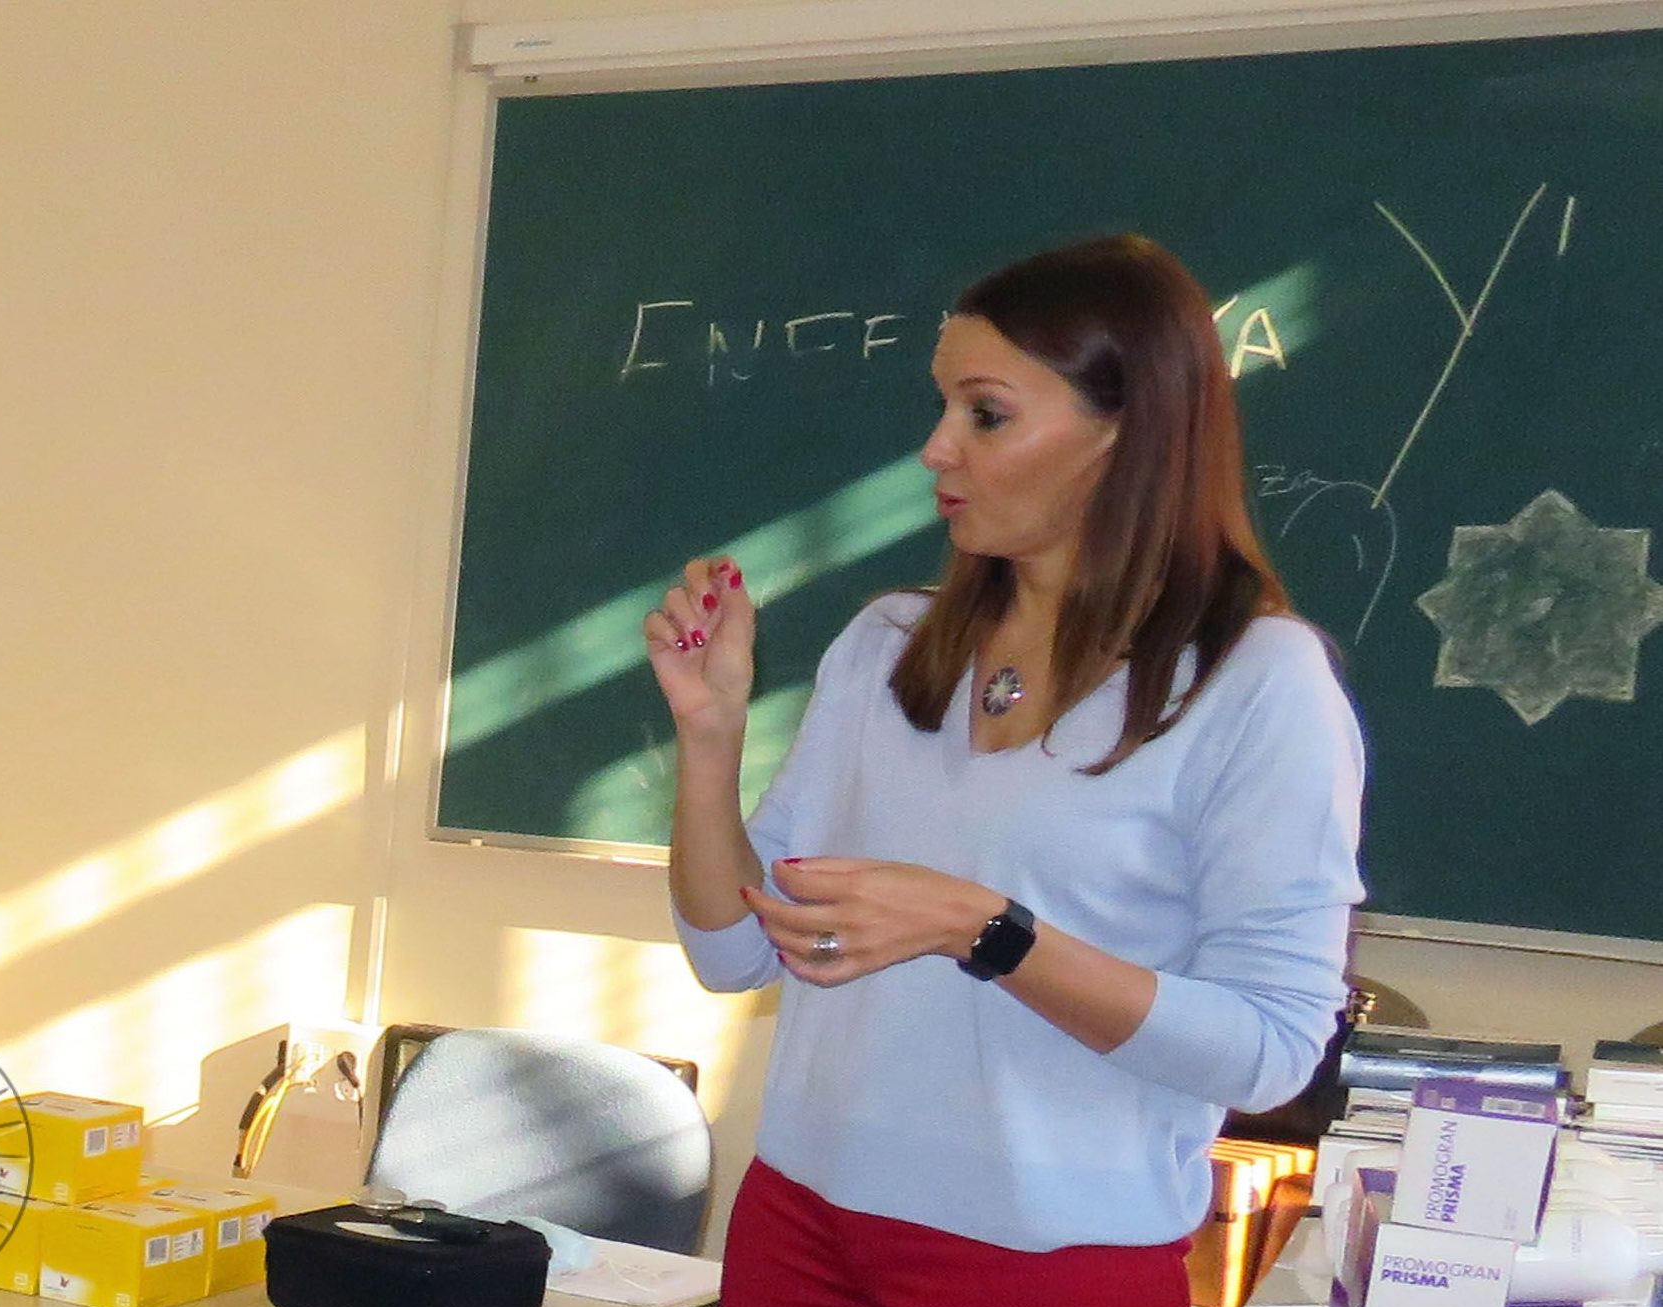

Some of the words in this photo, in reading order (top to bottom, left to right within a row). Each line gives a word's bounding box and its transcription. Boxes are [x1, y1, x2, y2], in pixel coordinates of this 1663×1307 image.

[1425, 1120, 1459, 1220] PROMOGRAN
[1441, 1163, 1468, 1223] PRISMA
[1380, 1269, 1450, 1289] PRISMA
[1383, 1254, 1501, 1281] PROMOGRAN
